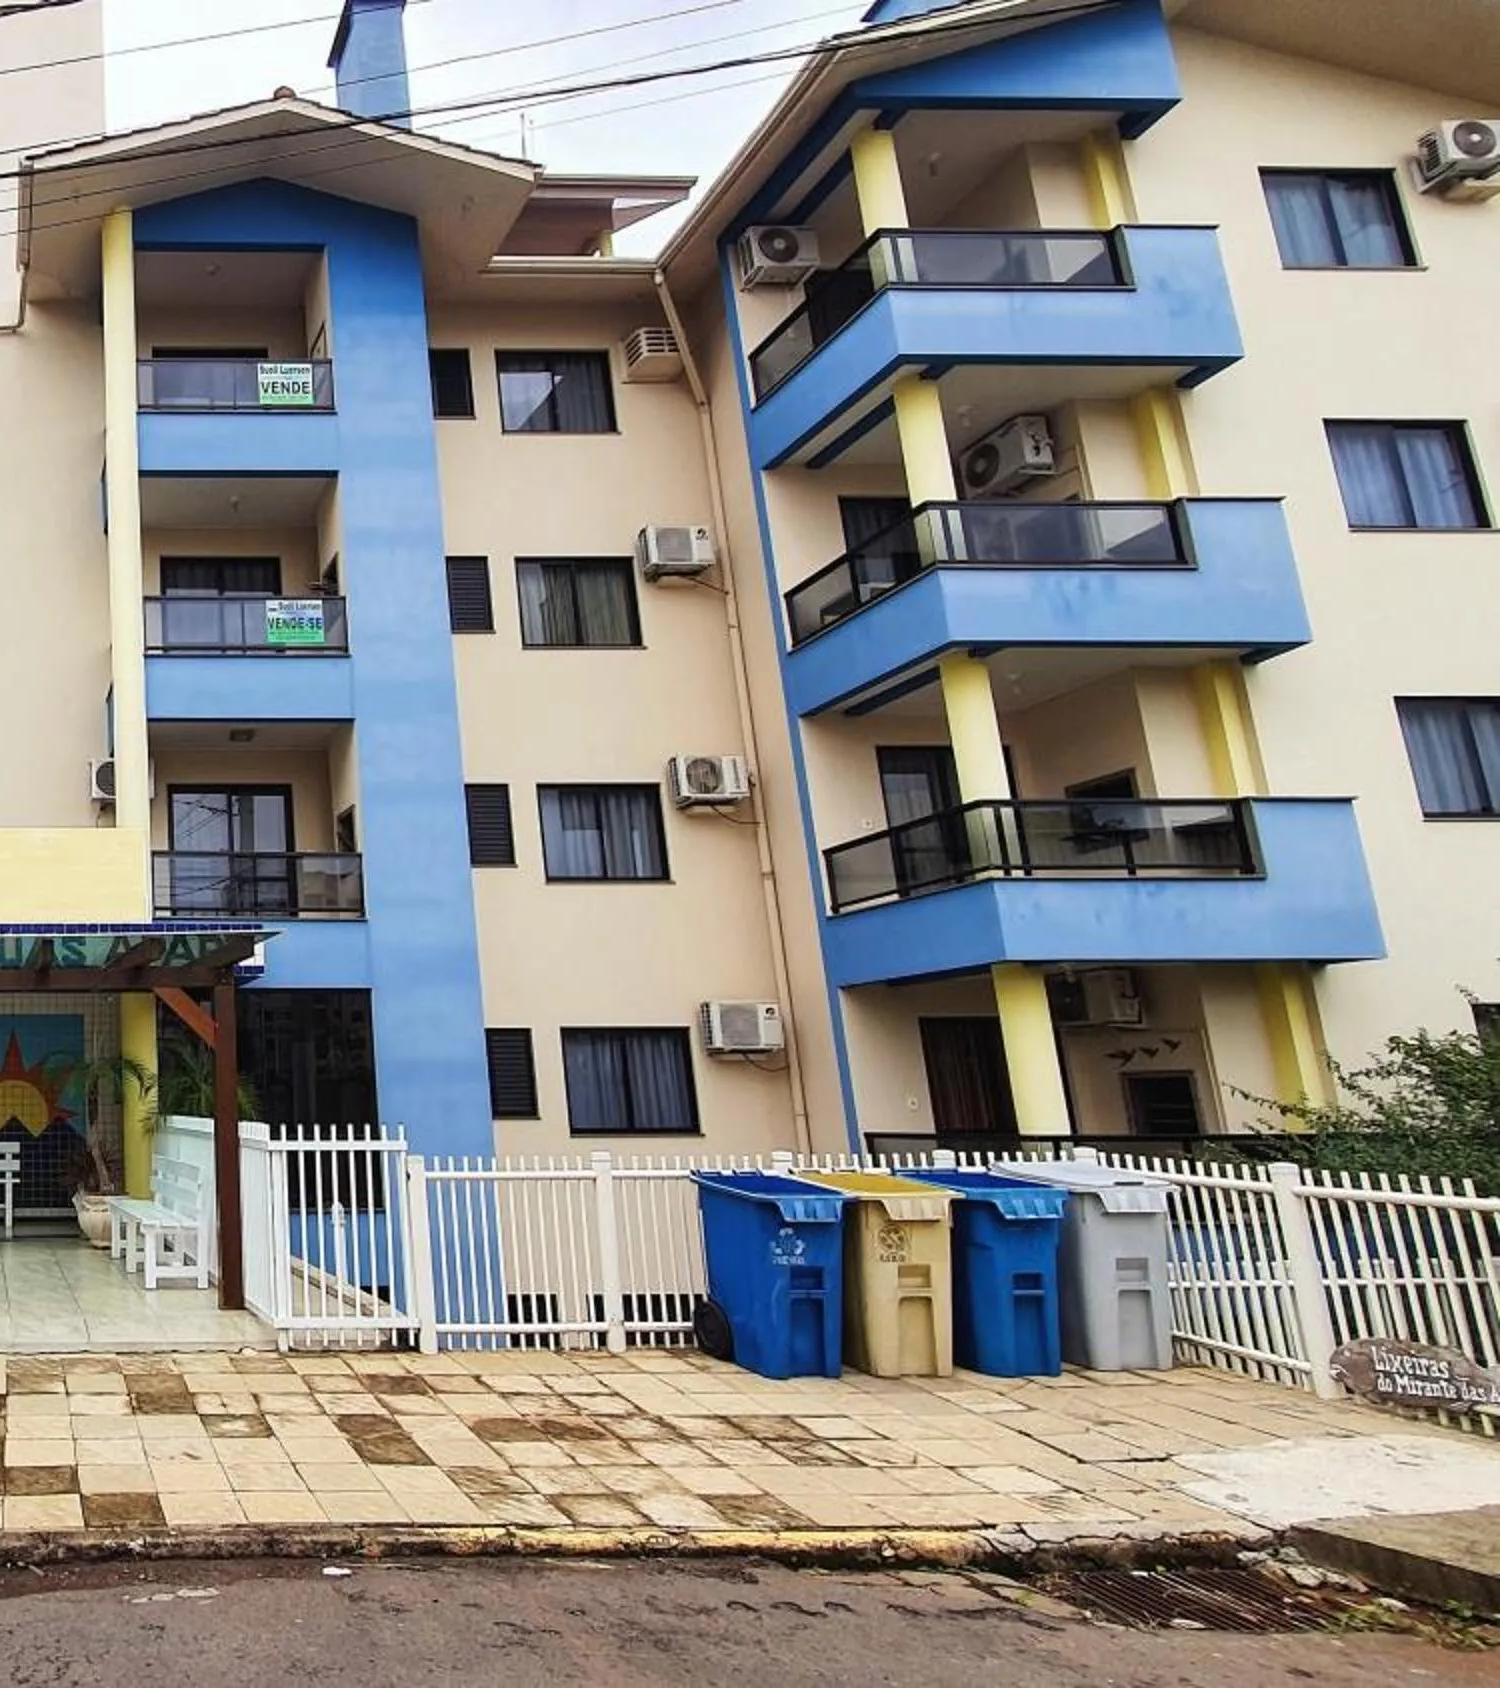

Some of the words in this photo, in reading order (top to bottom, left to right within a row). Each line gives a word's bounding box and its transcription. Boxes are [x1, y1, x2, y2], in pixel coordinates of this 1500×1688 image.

[261, 381, 310, 394] VENDE
[267, 617, 322, 630] VENDE-SE
[1371, 1346, 1449, 1378] Lixeiras
[1377, 1372, 1393, 1392] do
[1461, 1382, 1487, 1400] das
